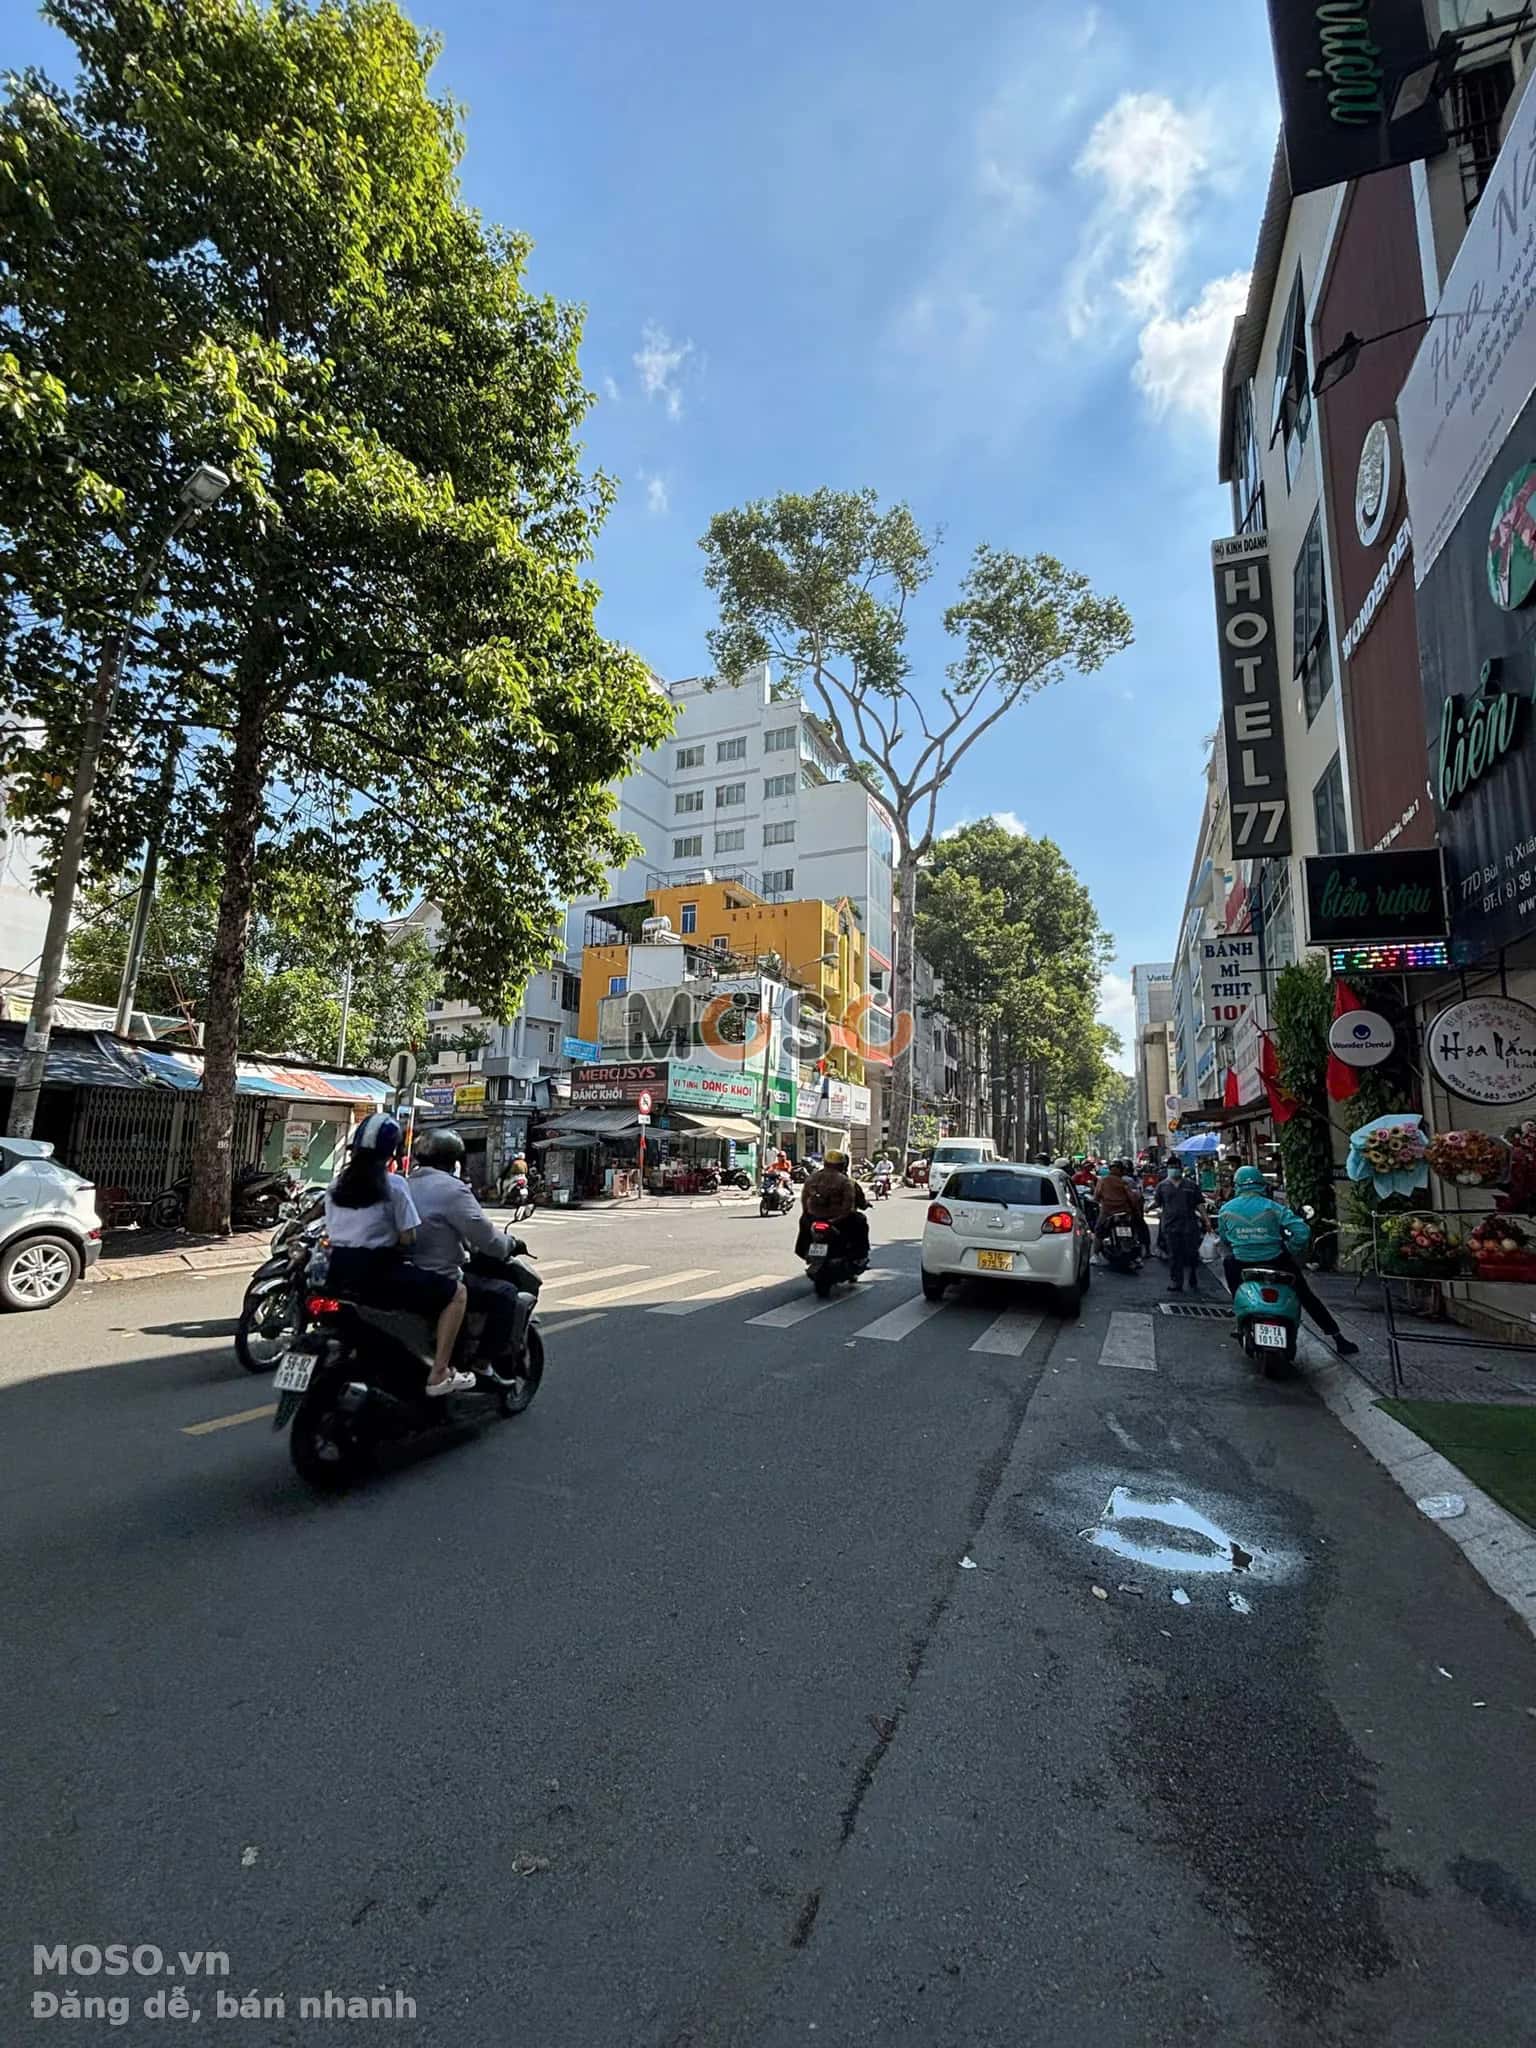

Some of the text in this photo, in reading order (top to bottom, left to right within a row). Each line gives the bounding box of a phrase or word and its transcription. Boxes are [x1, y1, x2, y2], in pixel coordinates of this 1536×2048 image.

[1432, 280, 1484, 406] Hoa
[1226, 541, 1242, 555] KINH
[1243, 536, 1268, 553] DOANH
[1341, 562, 1390, 662] WONDER
[1225, 565, 1286, 847] HOTEL 77
[1461, 871, 1481, 900] 77D
[1220, 960, 1241, 978] MÌ
[1211, 982, 1253, 1000] THỊT
[1333, 1039, 1392, 1049] Wonder Dental
[1440, 1031, 1488, 1061] Hoa
[1258, 1335, 1285, 1346] 10151
[1260, 1327, 1282, 1337] 59-TA
